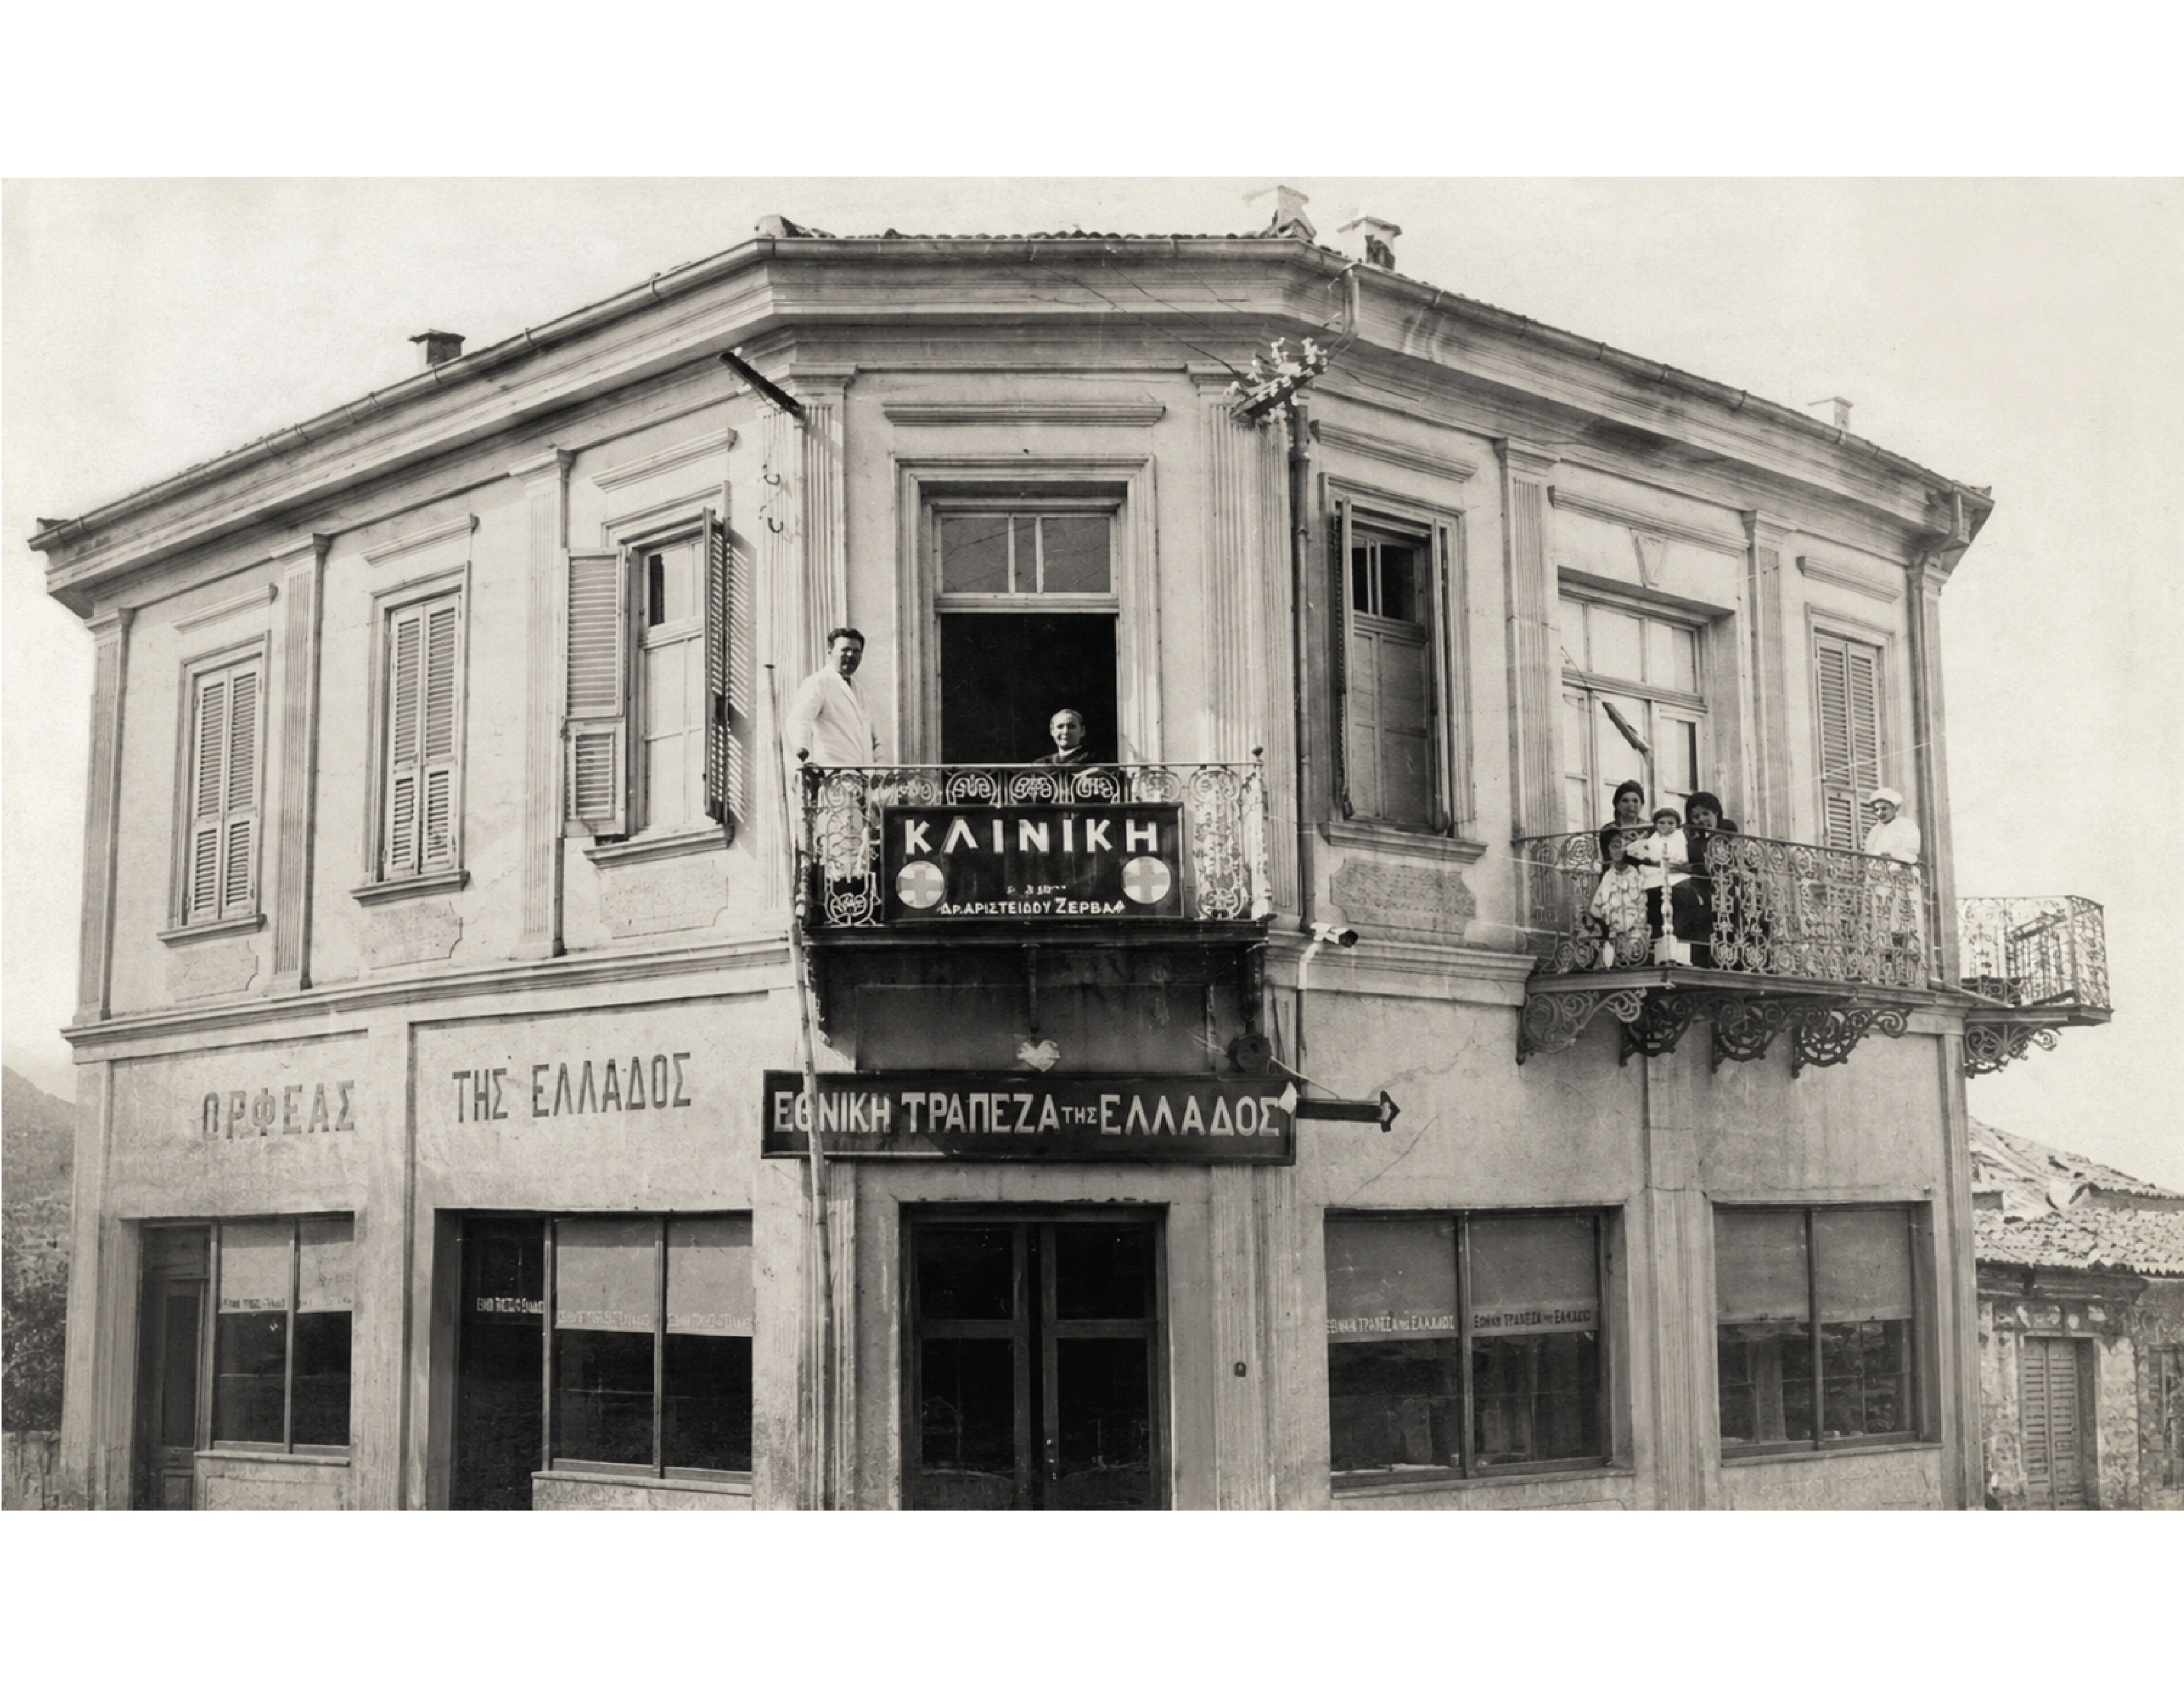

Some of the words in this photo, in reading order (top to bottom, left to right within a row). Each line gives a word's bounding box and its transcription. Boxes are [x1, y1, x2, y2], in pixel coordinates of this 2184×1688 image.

[905, 818, 1158, 855] ΚΛΙΝΙΚΗ
[453, 1068, 508, 1123] ΤΗΣ
[531, 1051, 691, 1119] ΕΛΛΑΔΟΣ
[901, 1092, 1059, 1135] ΤΡΑΠΕΖΑ
[1061, 1106, 1097, 1125] ΤΗΣ
[1101, 1093, 1280, 1136] ΕΛΛΑΔΟΣ
